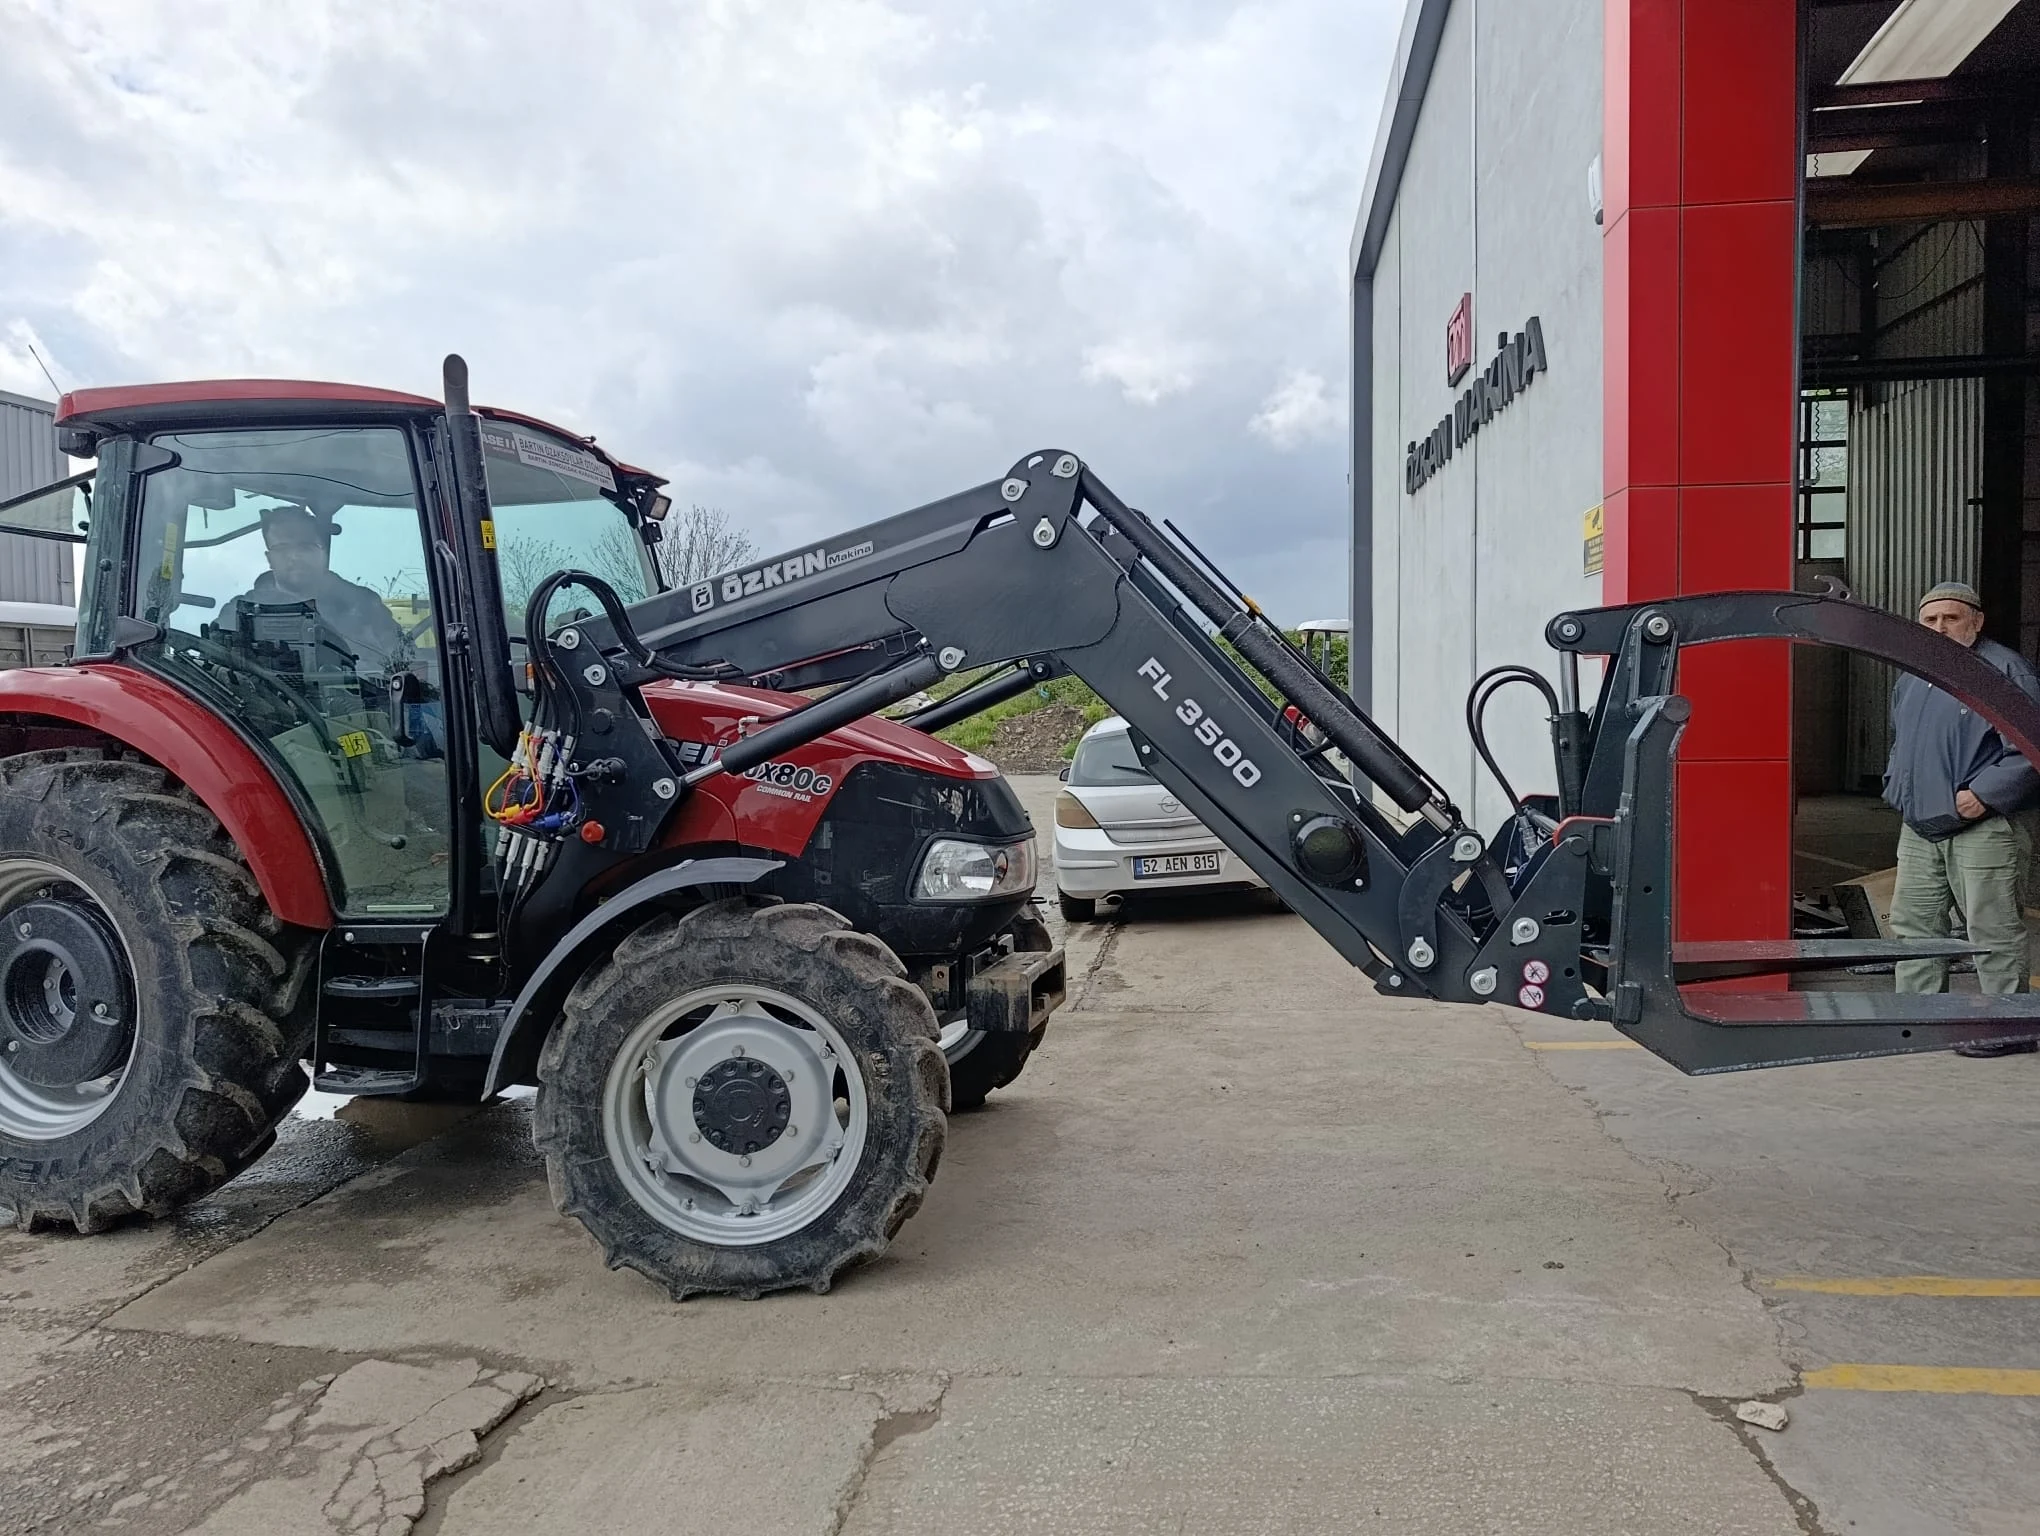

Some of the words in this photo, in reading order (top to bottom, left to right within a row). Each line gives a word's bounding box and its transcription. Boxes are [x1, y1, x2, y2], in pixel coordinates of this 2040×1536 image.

[482, 432, 505, 448] ASE
[1406, 413, 1453, 495] ÖZKAN
[721, 549, 828, 602] ÖZKAN
[829, 544, 872, 567] Makina
[1137, 656, 1172, 701] FL
[1175, 698, 1262, 788] 3500
[756, 784, 794, 799] COMMON
[793, 791, 813, 803] RAIL
[1143, 859, 1158, 873] 52
[1165, 856, 1188, 872] AEN
[1194, 855, 1215, 870] 815
